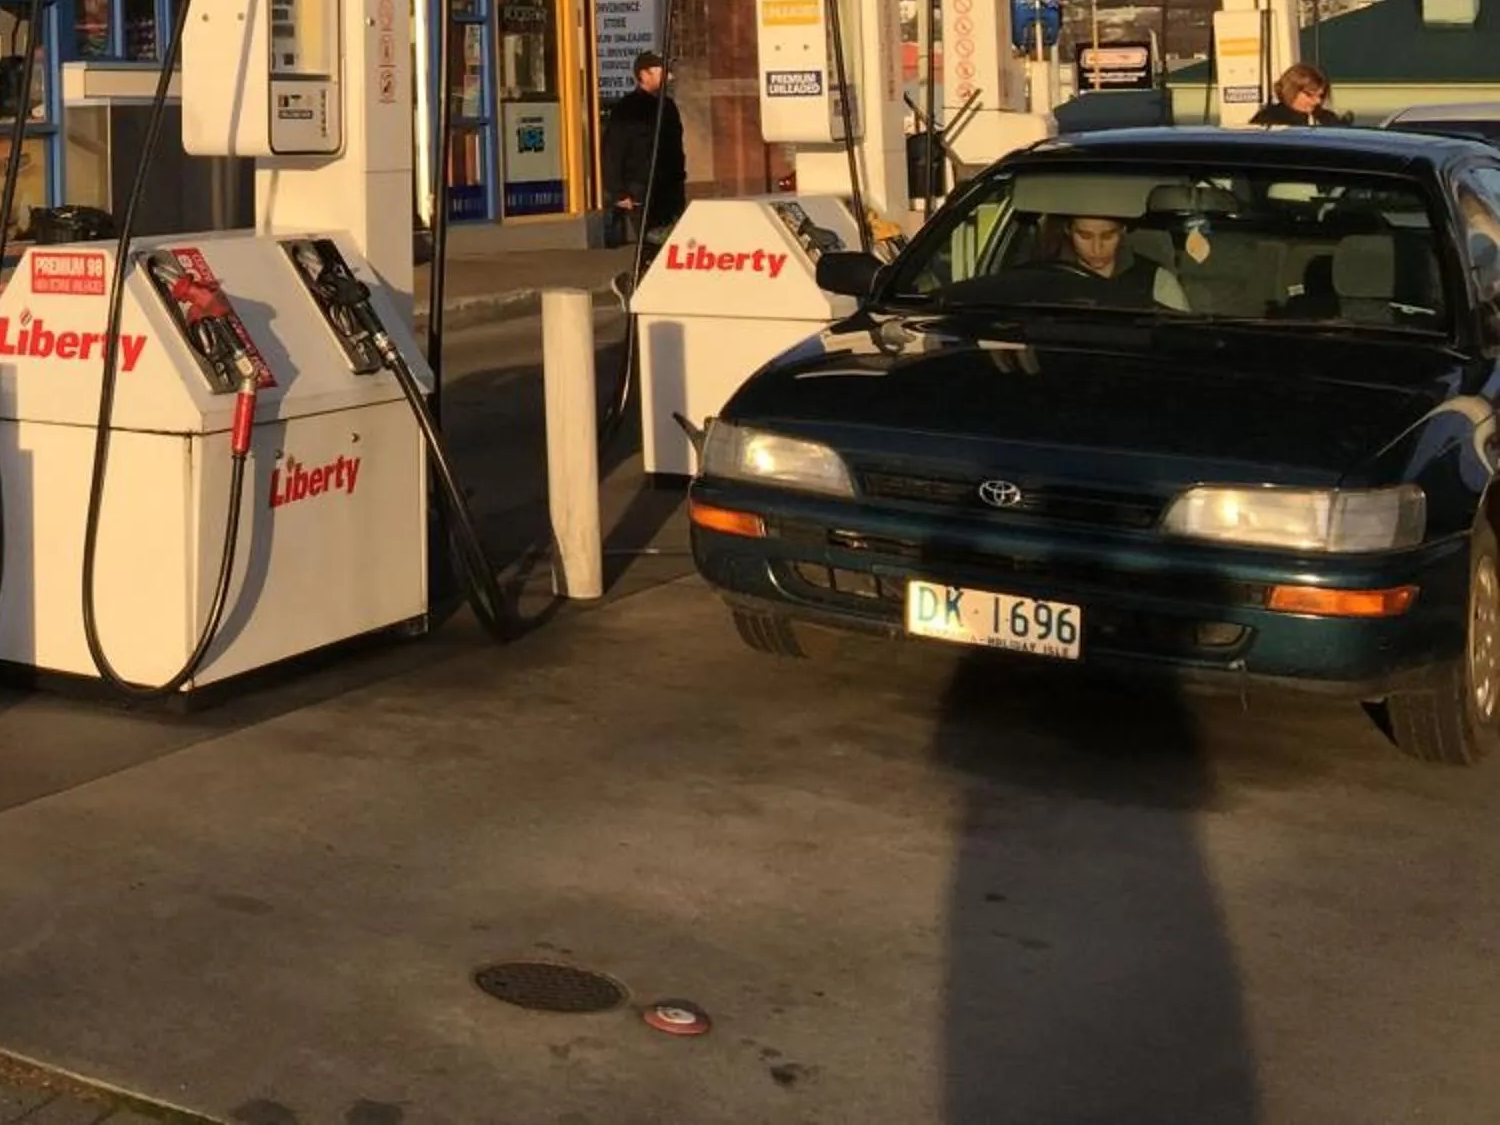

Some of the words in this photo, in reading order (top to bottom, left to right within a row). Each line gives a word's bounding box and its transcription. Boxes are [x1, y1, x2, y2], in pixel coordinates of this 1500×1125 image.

[34, 256, 85, 276] PREMIUM
[665, 237, 789, 279] Liberty
[268, 454, 361, 508] Liberty
[917, 585, 965, 628] DK
[992, 595, 1078, 646] 1696
